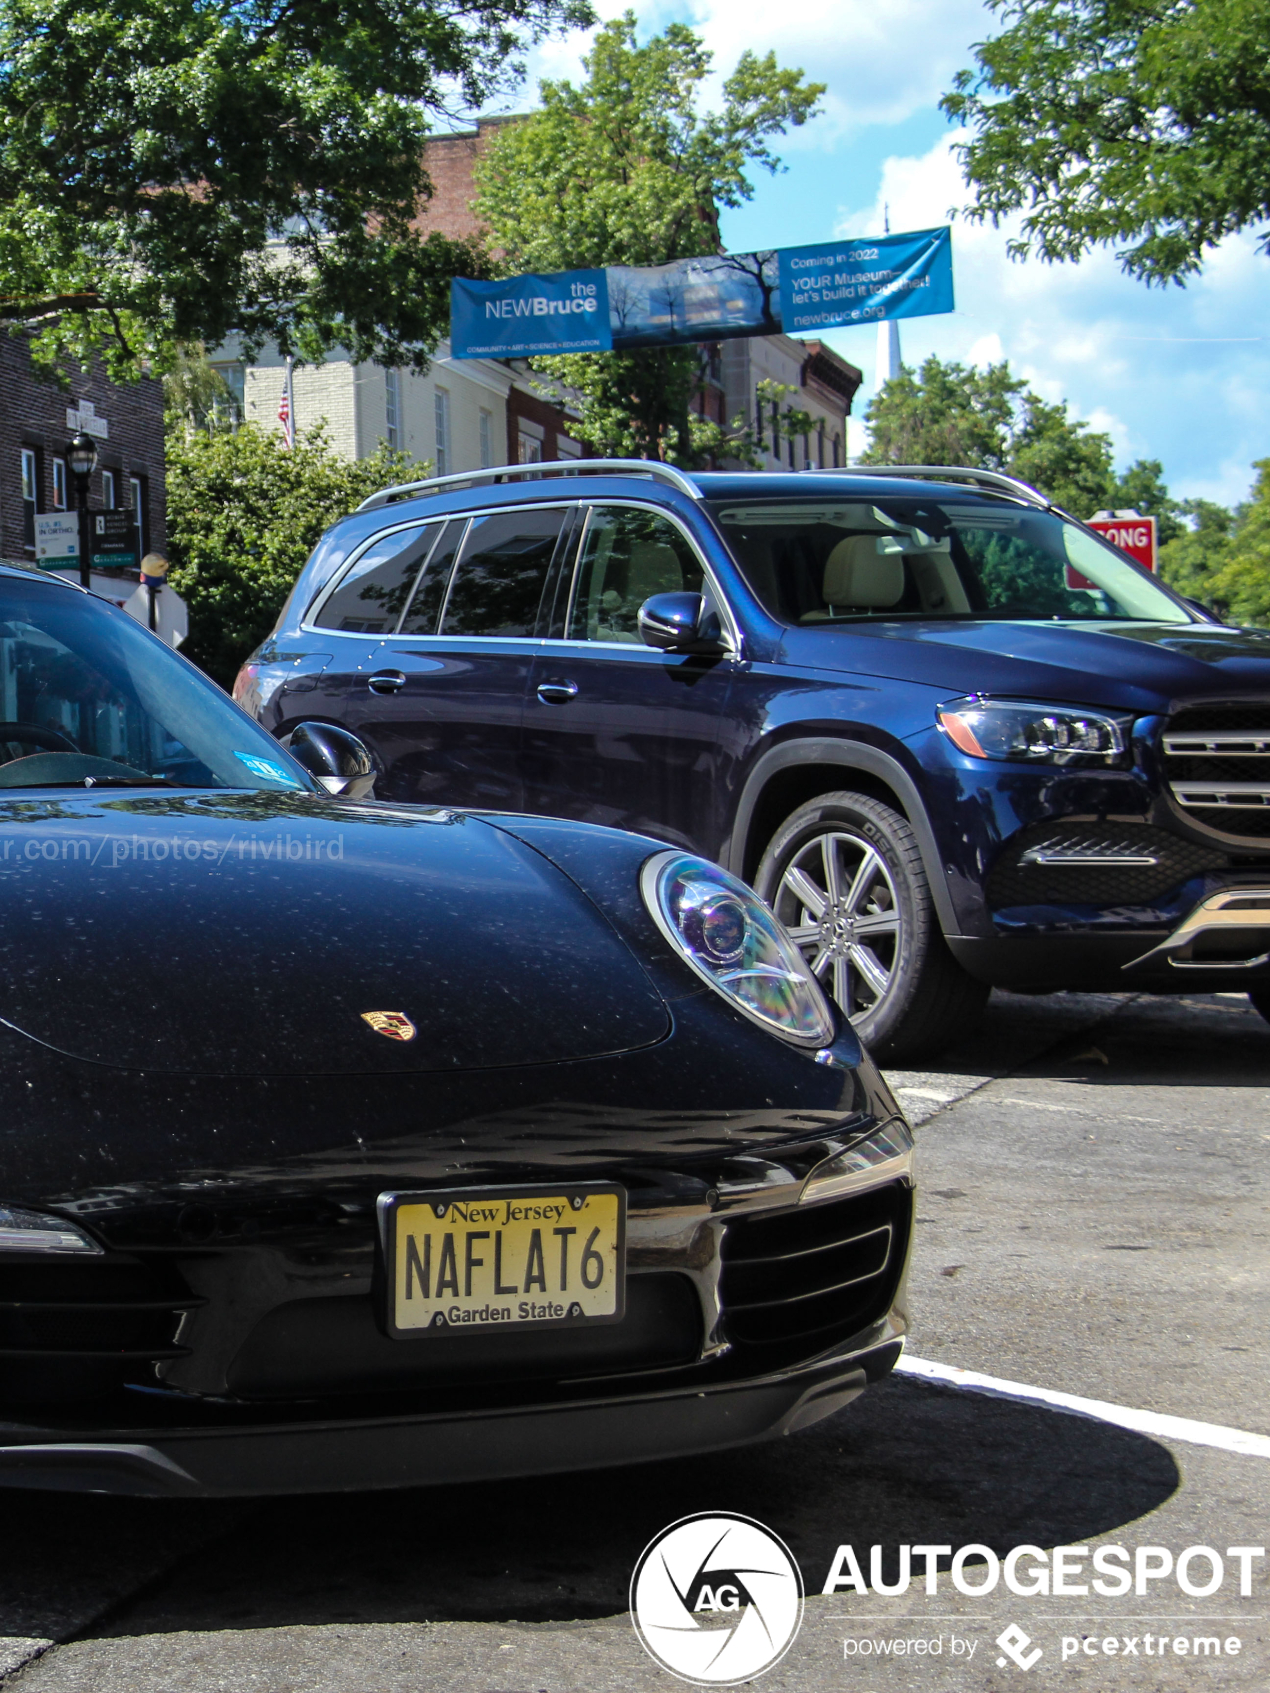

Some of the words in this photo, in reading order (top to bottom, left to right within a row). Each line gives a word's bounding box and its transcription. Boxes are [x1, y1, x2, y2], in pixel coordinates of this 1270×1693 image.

[790, 255, 834, 269] Coming
[836, 253, 847, 263] in
[848, 248, 879, 262] 2022
[570, 282, 597, 297] the
[791, 276, 832, 291] YOUR
[822, 285, 855, 300] build
[858, 284, 868, 297] it
[869, 275, 930, 296] together!
[794, 305, 886, 326] newbruce.org
[466, 344, 507, 353] COMMUNITY
[529, 342, 558, 350] SCIENCE
[562, 339, 600, 347] EDUCATION
[450, 1201, 499, 1224] New
[501, 1200, 566, 1226] Jersey
[405, 1226, 605, 1300] NAFLAT6
[447, 1302, 511, 1324] Garden
[517, 1301, 564, 1320] State
